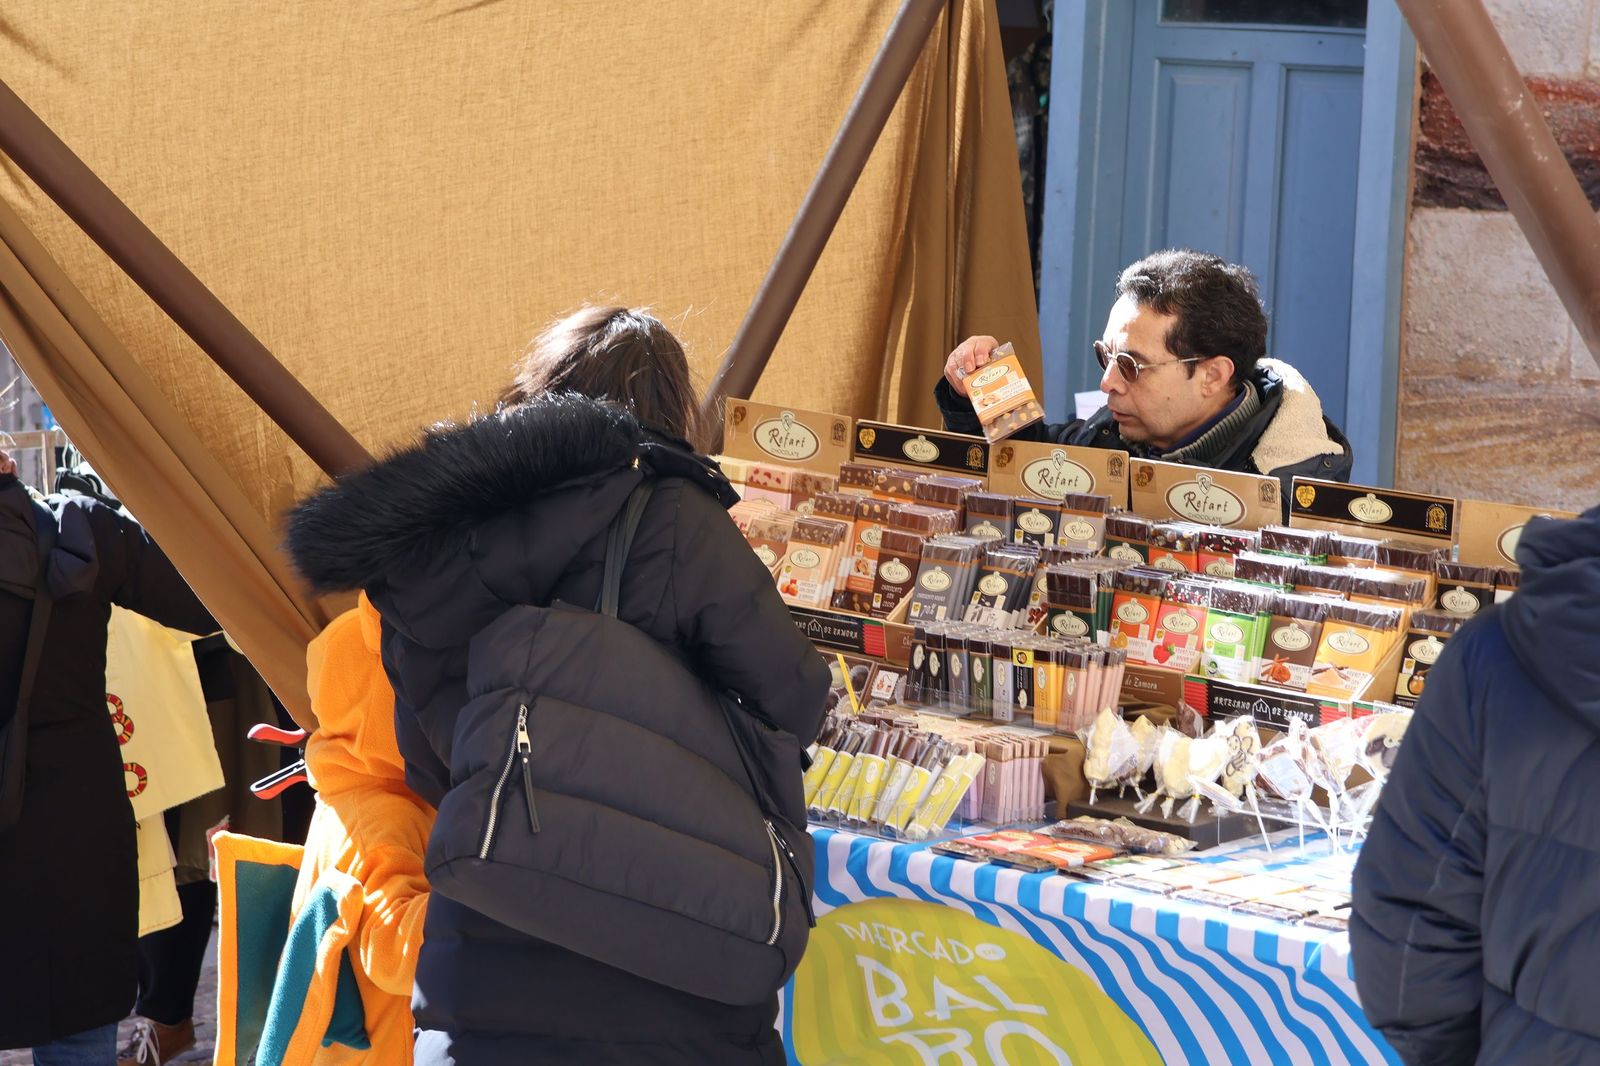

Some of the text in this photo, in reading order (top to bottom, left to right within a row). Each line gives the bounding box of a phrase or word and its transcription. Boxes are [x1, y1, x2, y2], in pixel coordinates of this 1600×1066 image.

[768, 427, 806, 448] Refart
[1037, 467, 1079, 489] Refart
[1183, 490, 1228, 513] Refart
[1359, 502, 1383, 515] Refart
[1187, 511, 1223, 524] CHOCOLATE
[833, 628, 859, 640] ZAMORA
[1134, 676, 1158, 690] Zamora
[1213, 696, 1251, 710] ARTESANO
[836, 921, 1007, 965] MERCADO
[855, 953, 1049, 1028] BAL
